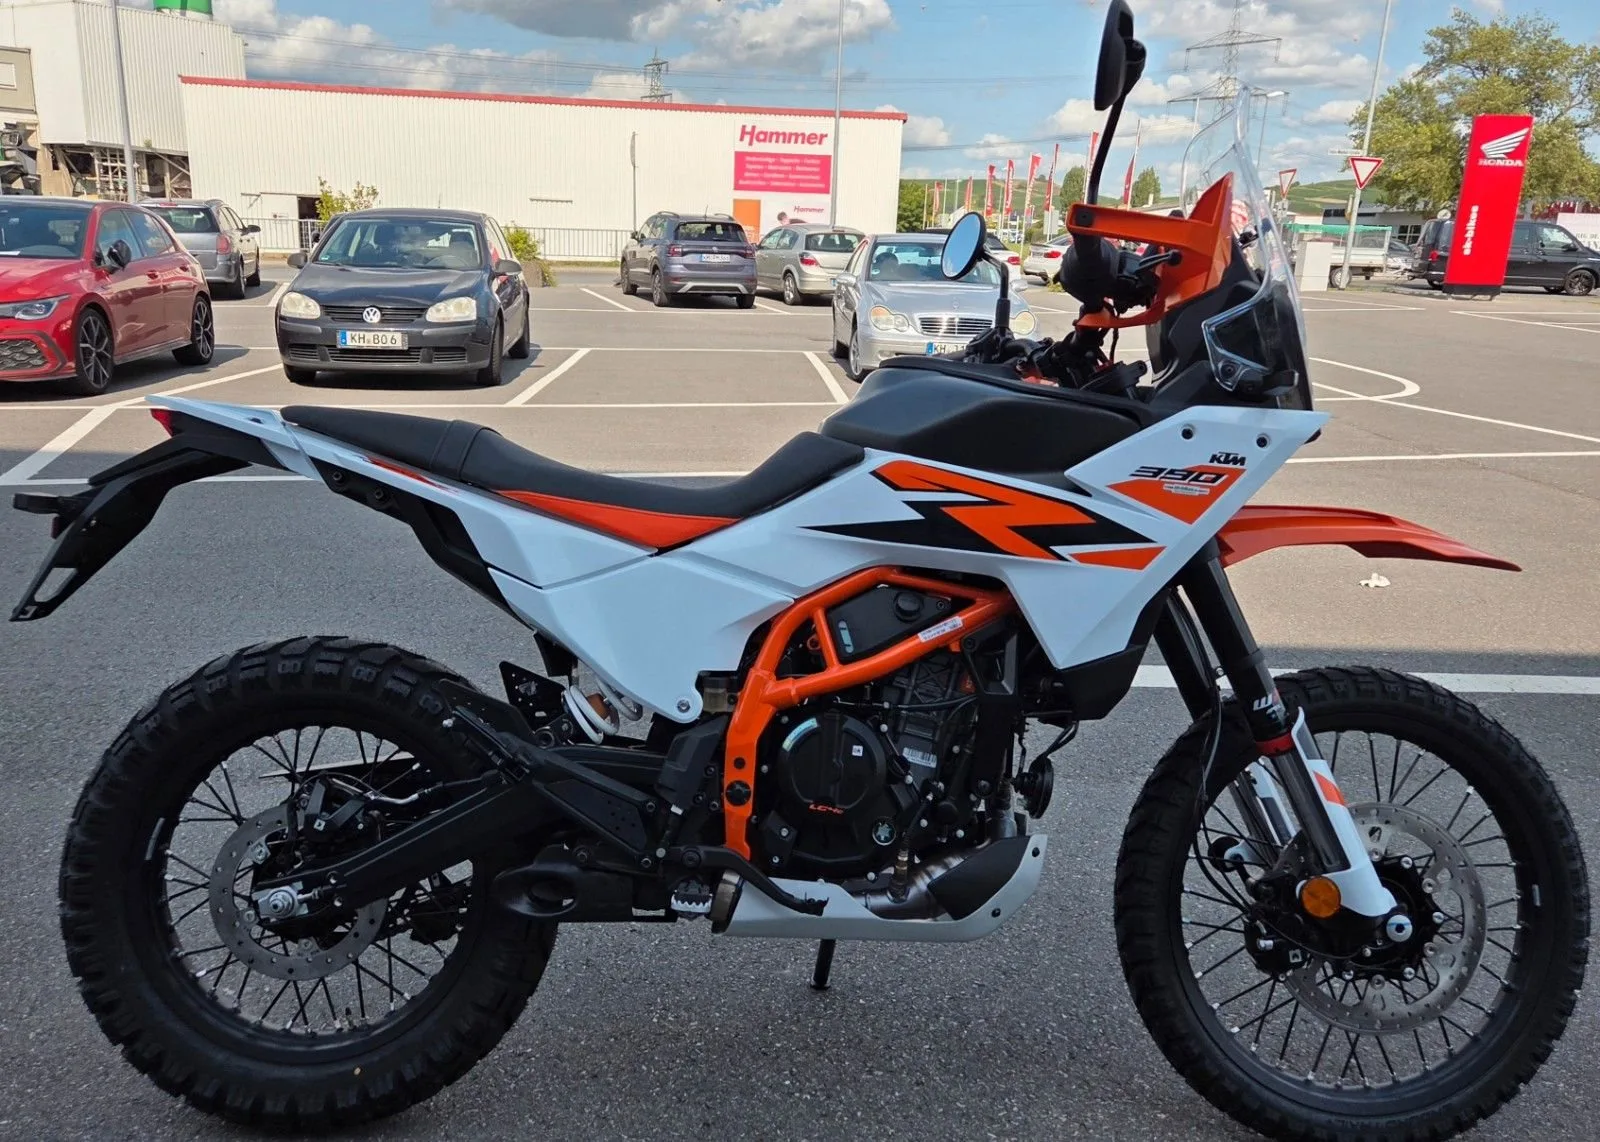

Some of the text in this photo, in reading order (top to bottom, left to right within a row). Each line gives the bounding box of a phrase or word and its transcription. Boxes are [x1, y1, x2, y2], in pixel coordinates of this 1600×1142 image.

[739, 124, 828, 146] Hammer
[1478, 159, 1524, 167] HONDA
[794, 206, 824, 214] Hammer
[350, 333, 366, 344] KH
[1209, 451, 1247, 466] KTM
[1129, 466, 1228, 484] 390
